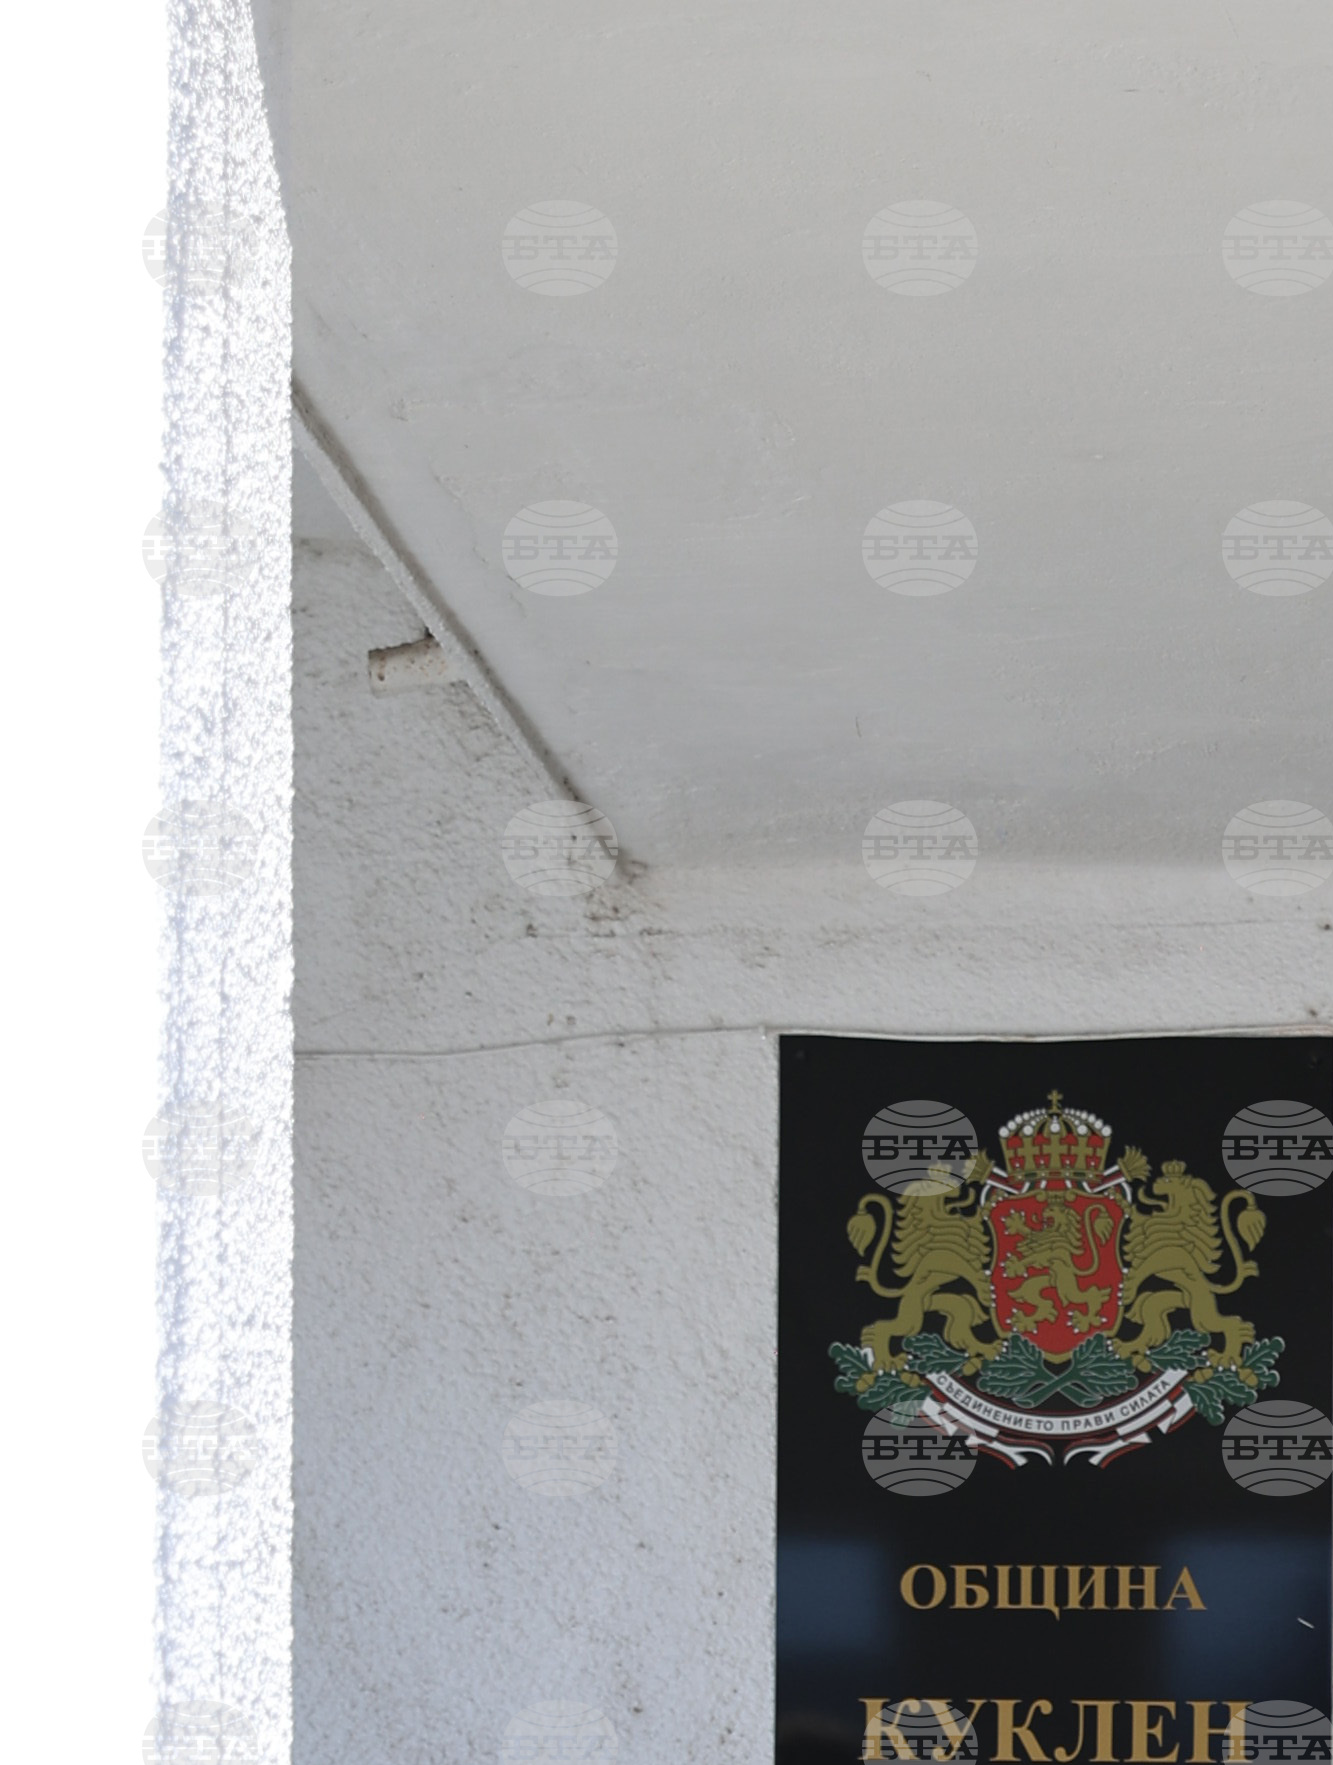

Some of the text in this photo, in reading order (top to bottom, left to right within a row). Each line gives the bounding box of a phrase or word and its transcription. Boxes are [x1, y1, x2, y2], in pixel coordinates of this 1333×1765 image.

[936, 1374, 1171, 1432] СЪЕДИНЕНИЕТО ПРАВИ СИЛАТА
[899, 1563, 1208, 1622] ОБЩИНА
[858, 1697, 1254, 1764] КУКЛЕН
